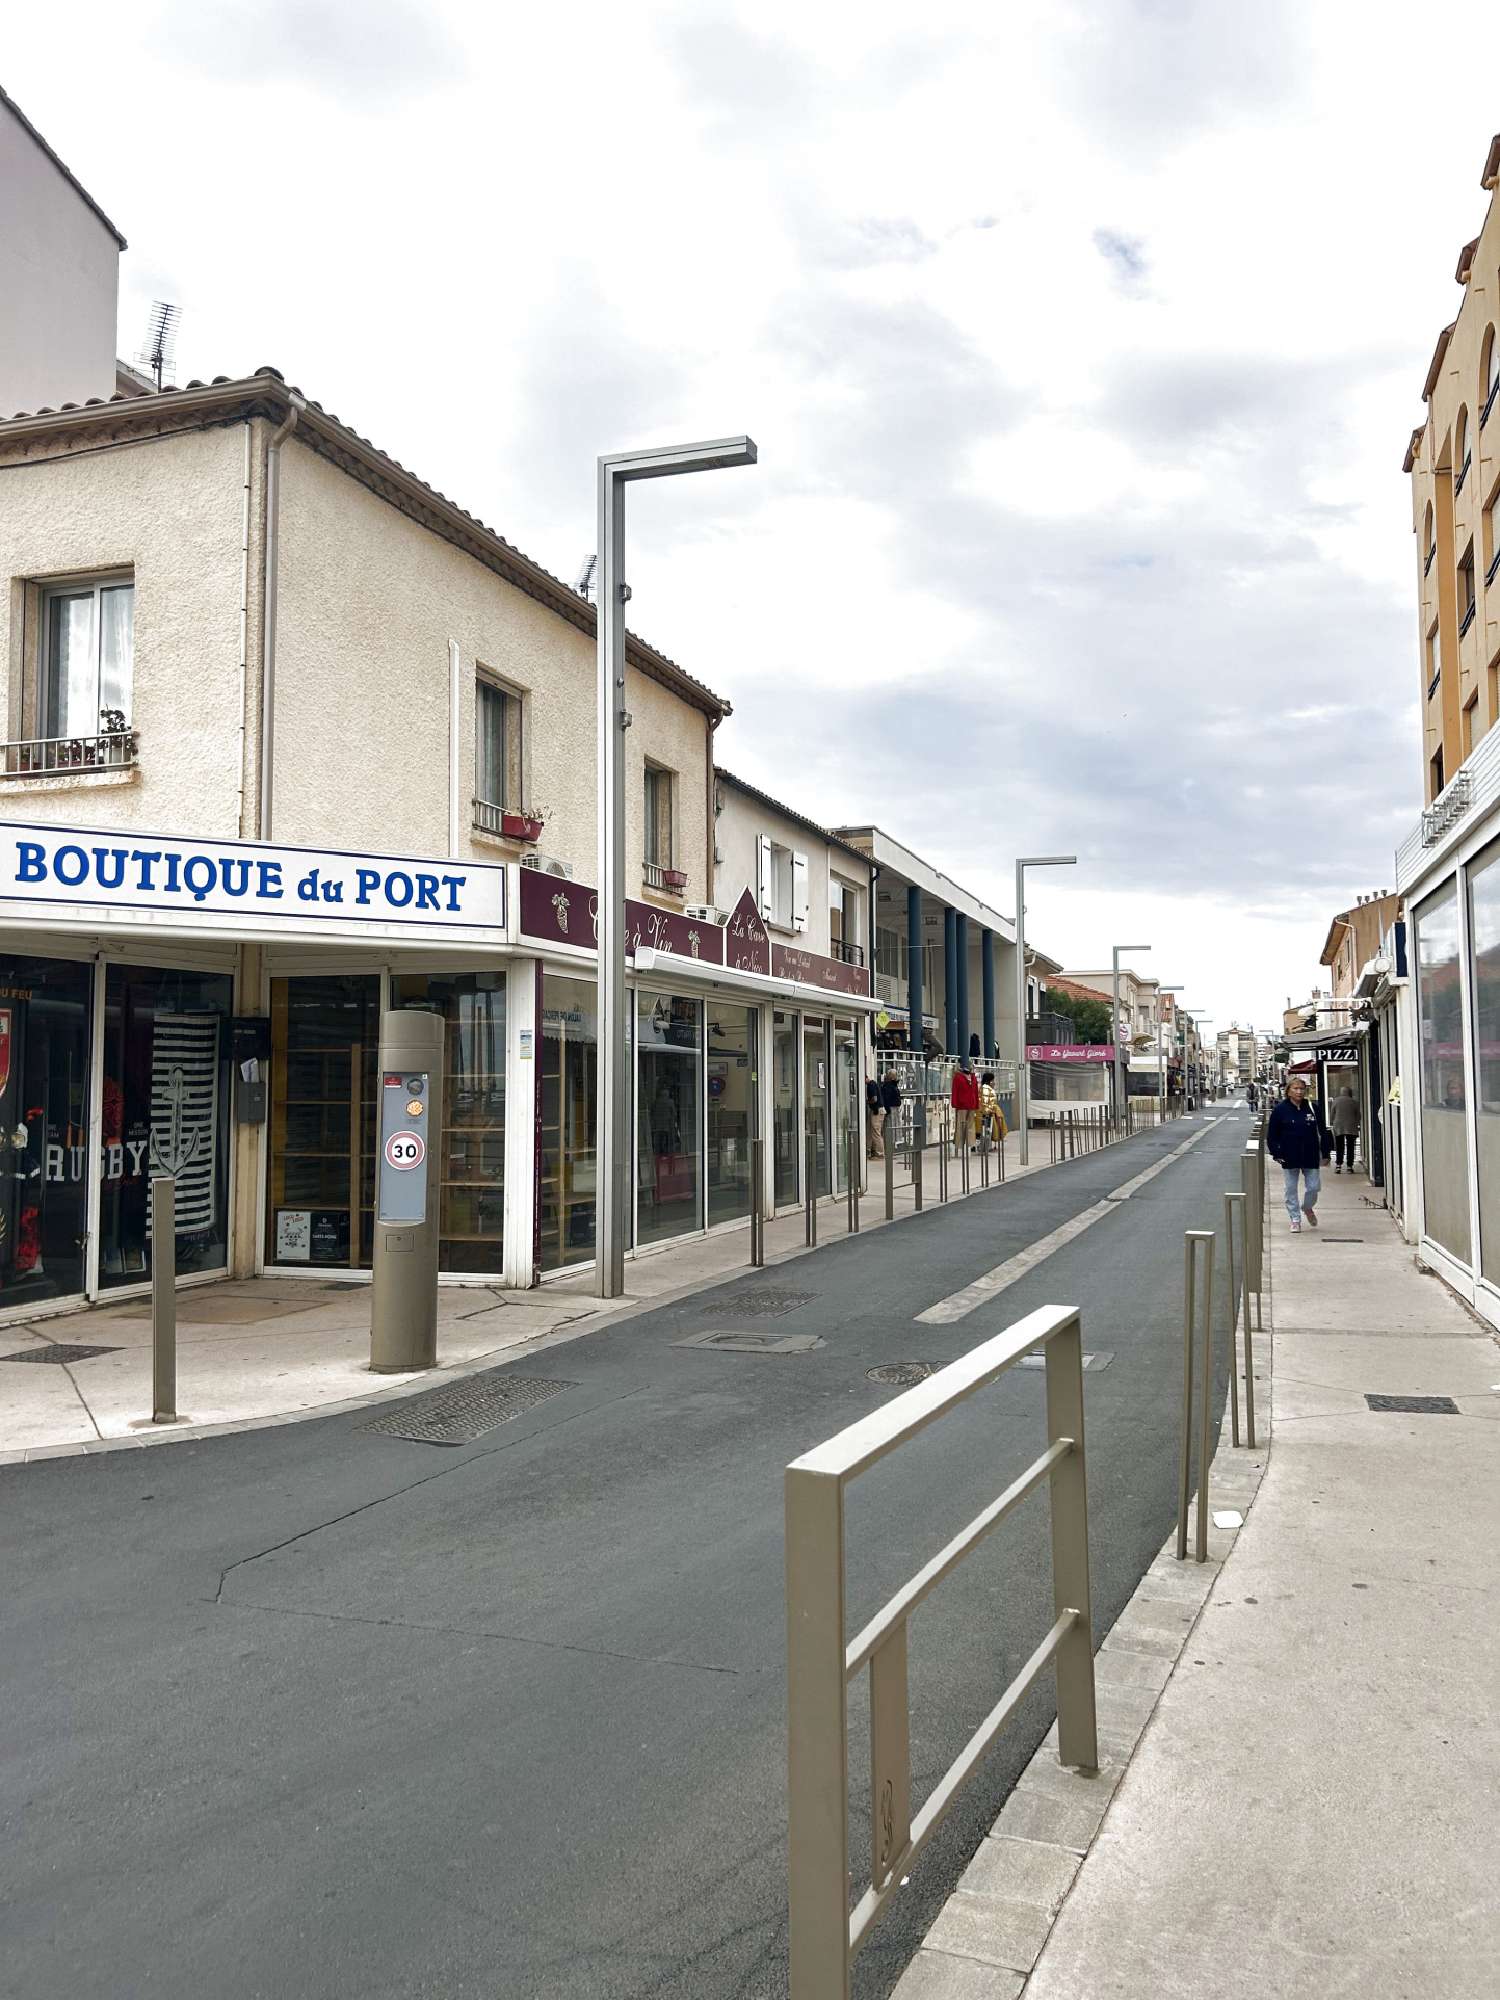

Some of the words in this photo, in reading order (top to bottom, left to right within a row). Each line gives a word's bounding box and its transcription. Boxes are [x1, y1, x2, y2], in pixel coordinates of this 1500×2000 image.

[15, 841, 283, 902] BOUTIQUE
[298, 869, 343, 902] du
[356, 869, 467, 911] PORT
[46, 1141, 147, 1181] RUBY
[394, 1145, 417, 1159] 30
